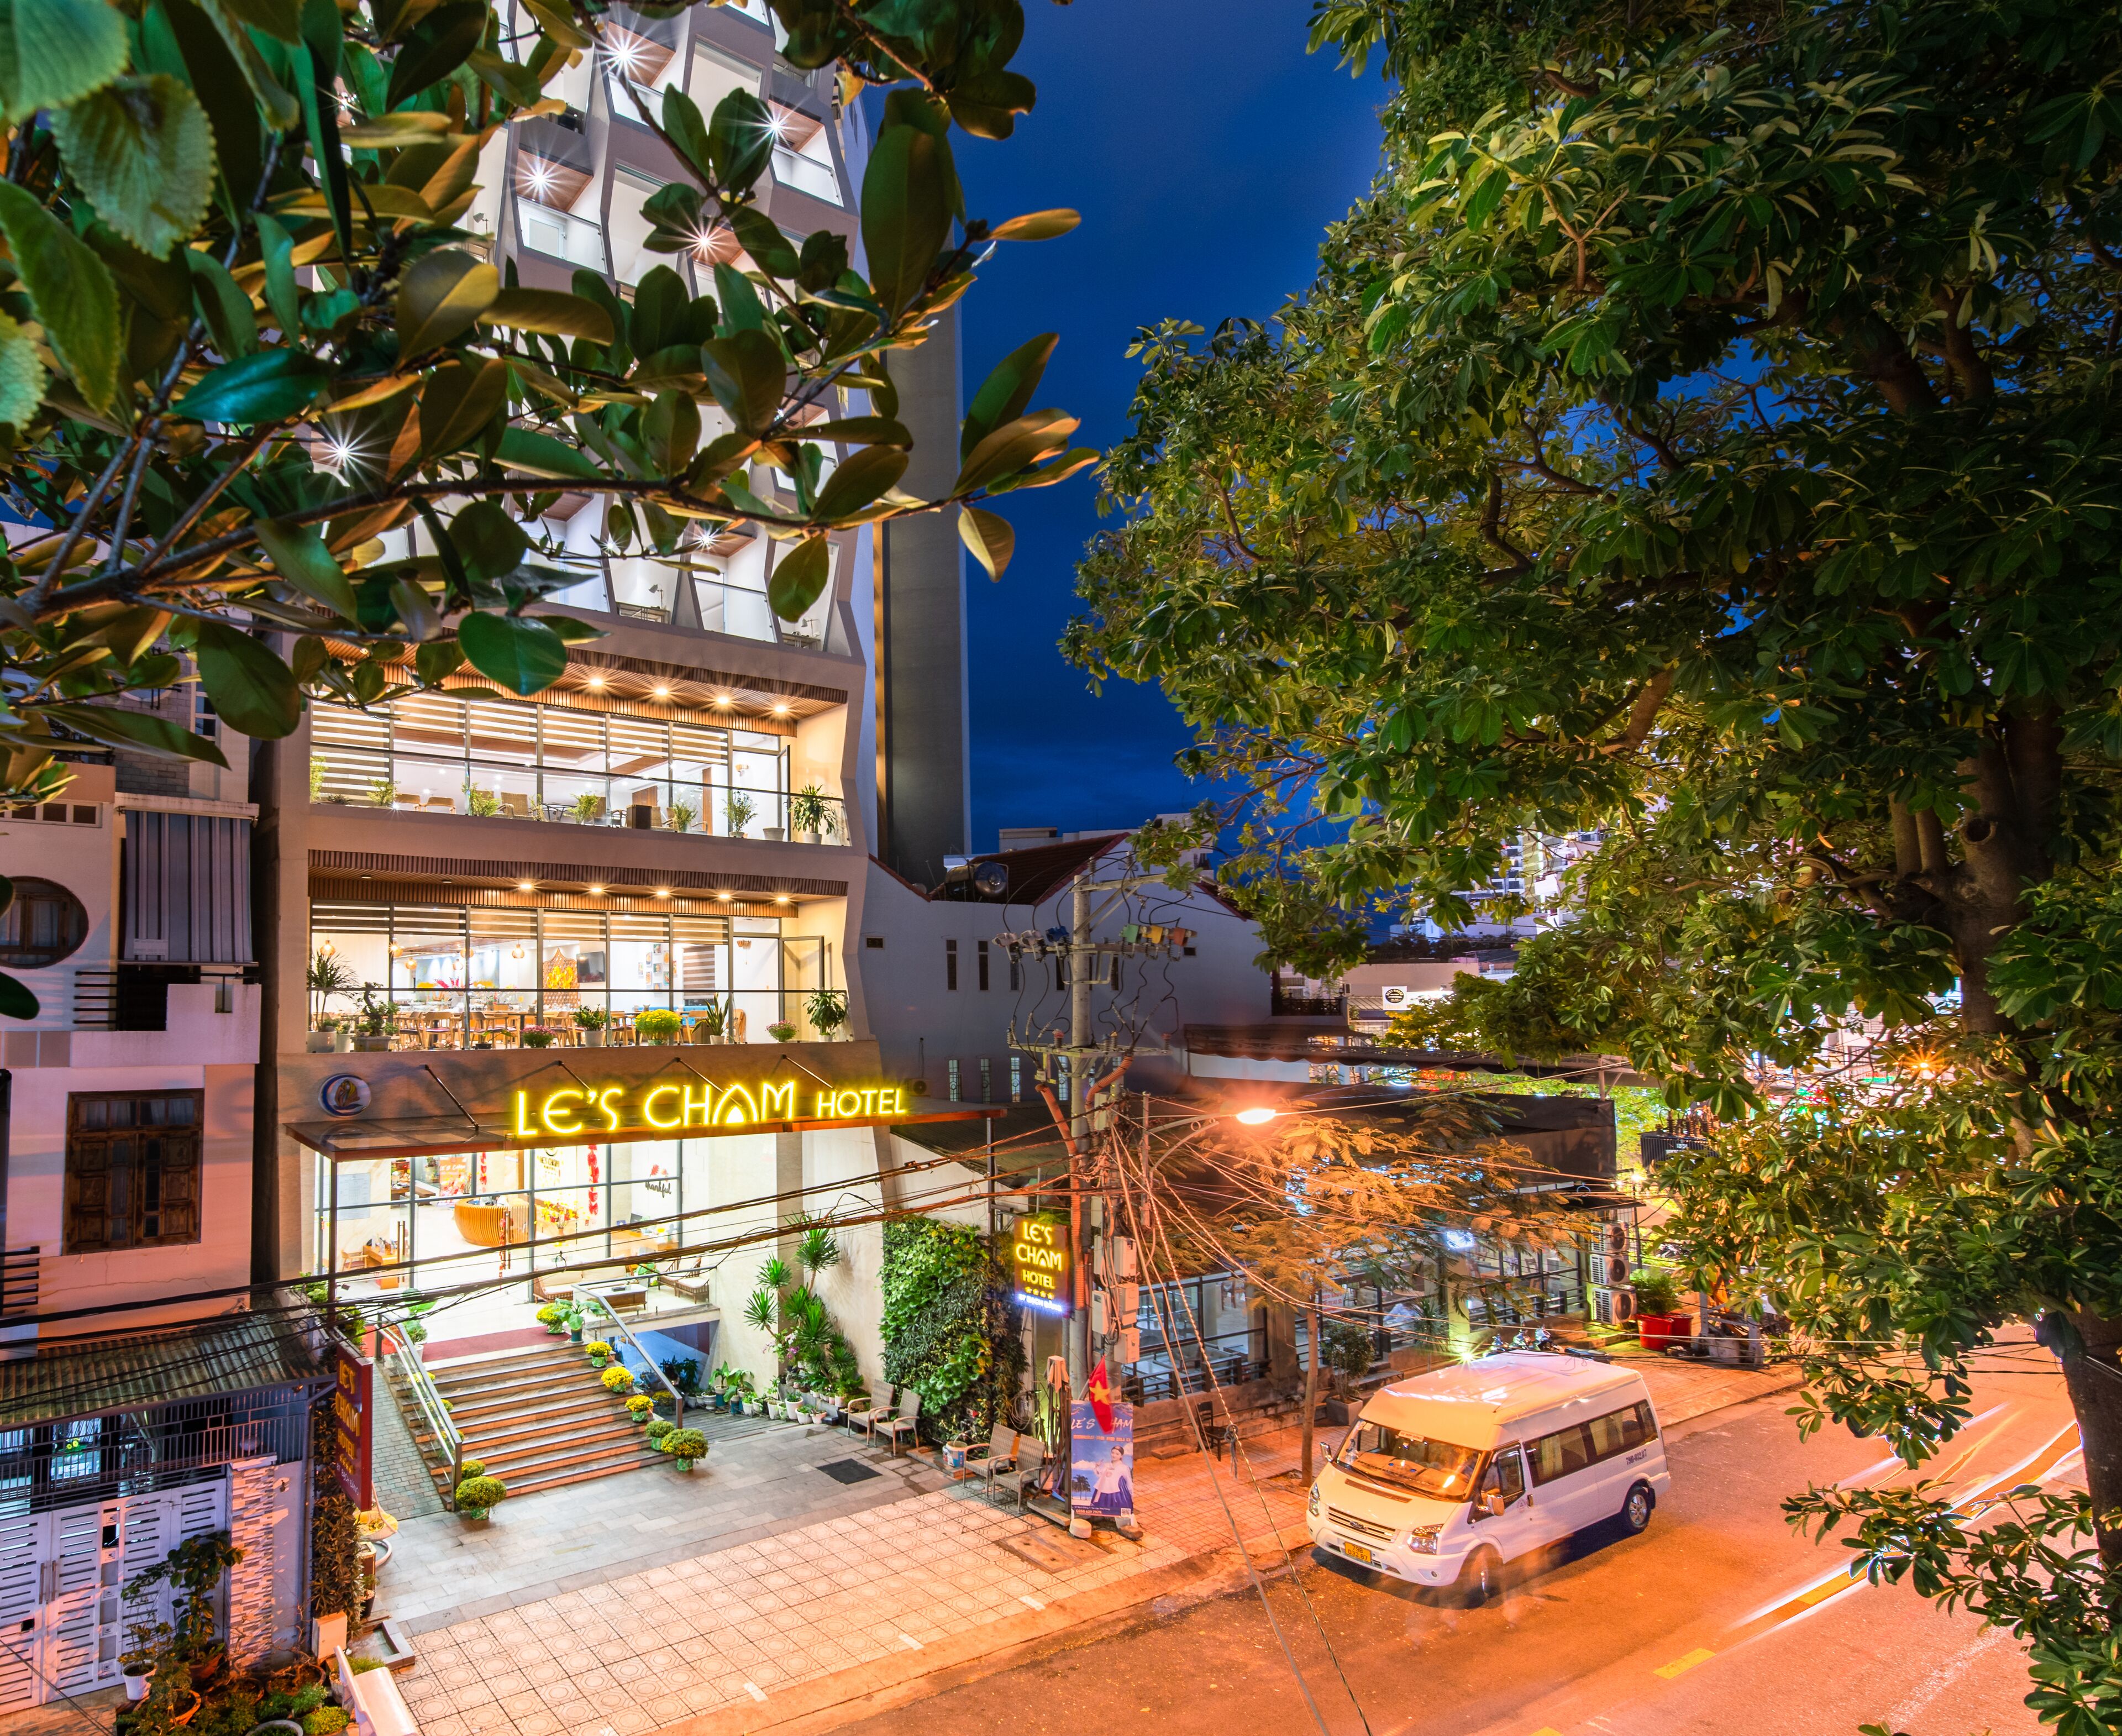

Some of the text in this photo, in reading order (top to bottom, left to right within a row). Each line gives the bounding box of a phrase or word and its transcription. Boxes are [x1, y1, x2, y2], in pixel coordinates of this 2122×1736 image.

[516, 1079, 907, 1137] LE'S CHAM HOTEL
[1023, 1221, 1053, 1245] LE'S
[1015, 1244, 1063, 1272] CHAM
[1022, 1269, 1055, 1289] HOTEL
[335, 1392, 360, 1437] CHAM
[1071, 1417, 1095, 1430] LE'S
[338, 1428, 355, 1460] HOTEL
